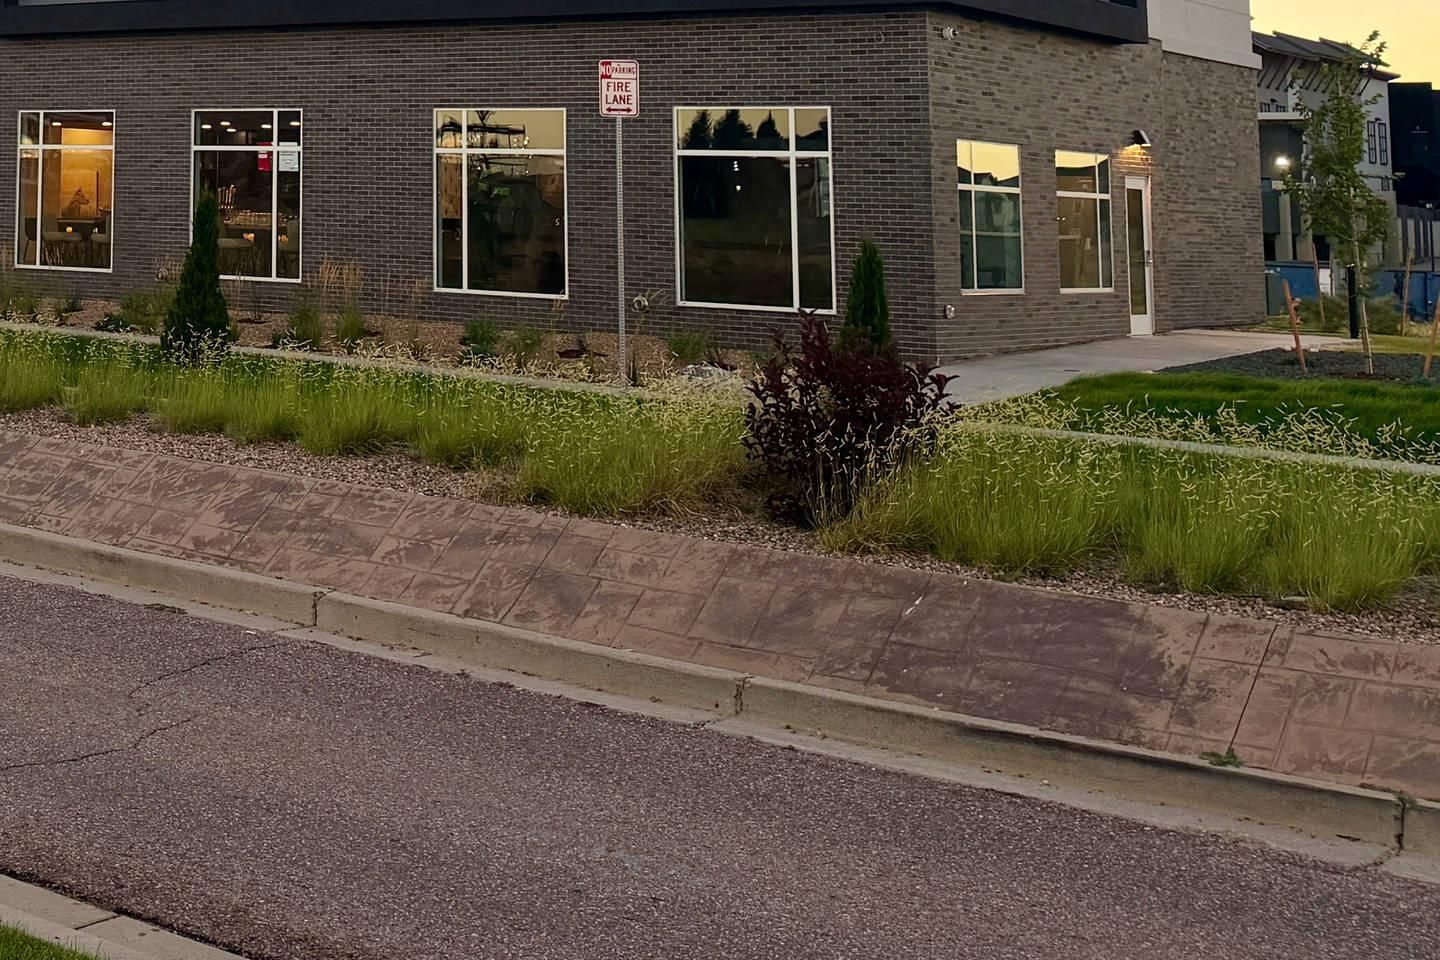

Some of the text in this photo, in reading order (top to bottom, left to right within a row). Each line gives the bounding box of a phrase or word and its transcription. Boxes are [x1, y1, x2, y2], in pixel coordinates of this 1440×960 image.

[601, 64, 635, 76] NO PARKING
[606, 81, 632, 92] FIRE
[605, 94, 633, 105] LANE
